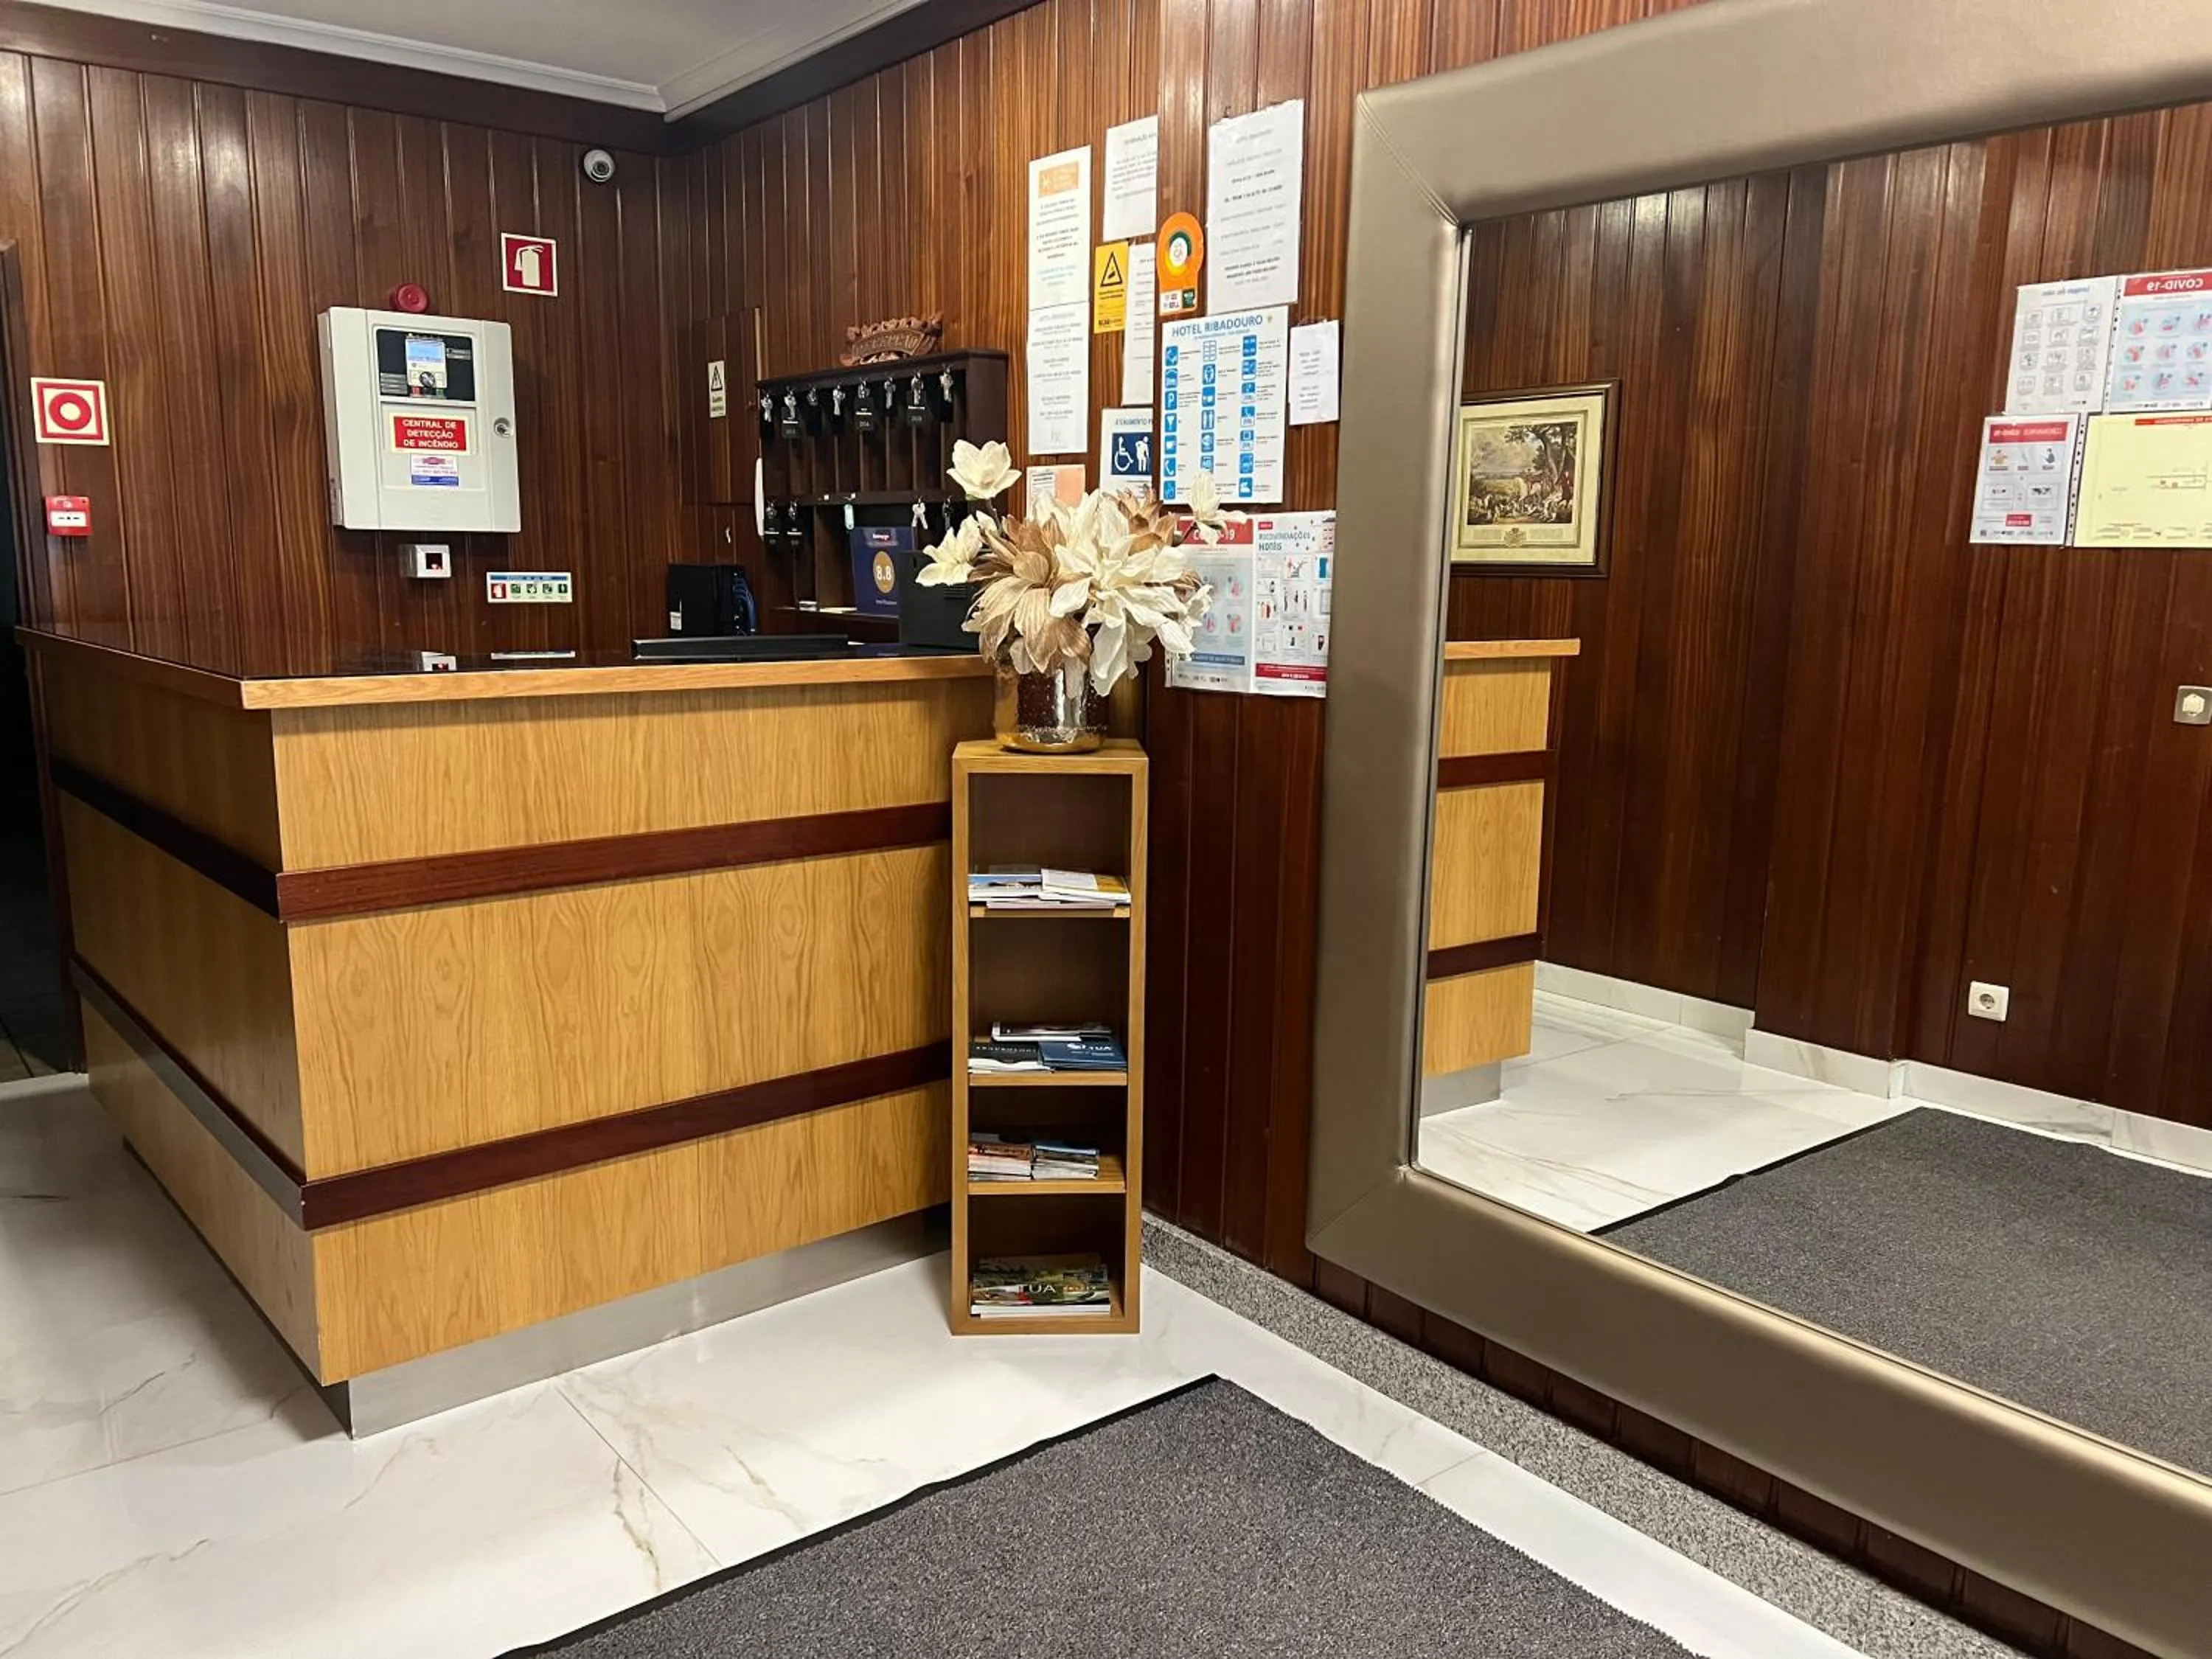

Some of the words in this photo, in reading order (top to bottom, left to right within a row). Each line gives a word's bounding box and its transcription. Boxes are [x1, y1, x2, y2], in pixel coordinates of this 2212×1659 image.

[1172, 323, 1203, 337] HOTEL
[1205, 315, 1263, 333] RIBADOURO
[402, 419, 442, 428] CENTRAL
[445, 421, 456, 429] DE
[406, 429, 453, 439] DETECÇÃO
[403, 439, 415, 447] DE
[418, 439, 459, 449] INCÊNDIO
[875, 566, 891, 580] 8.8
